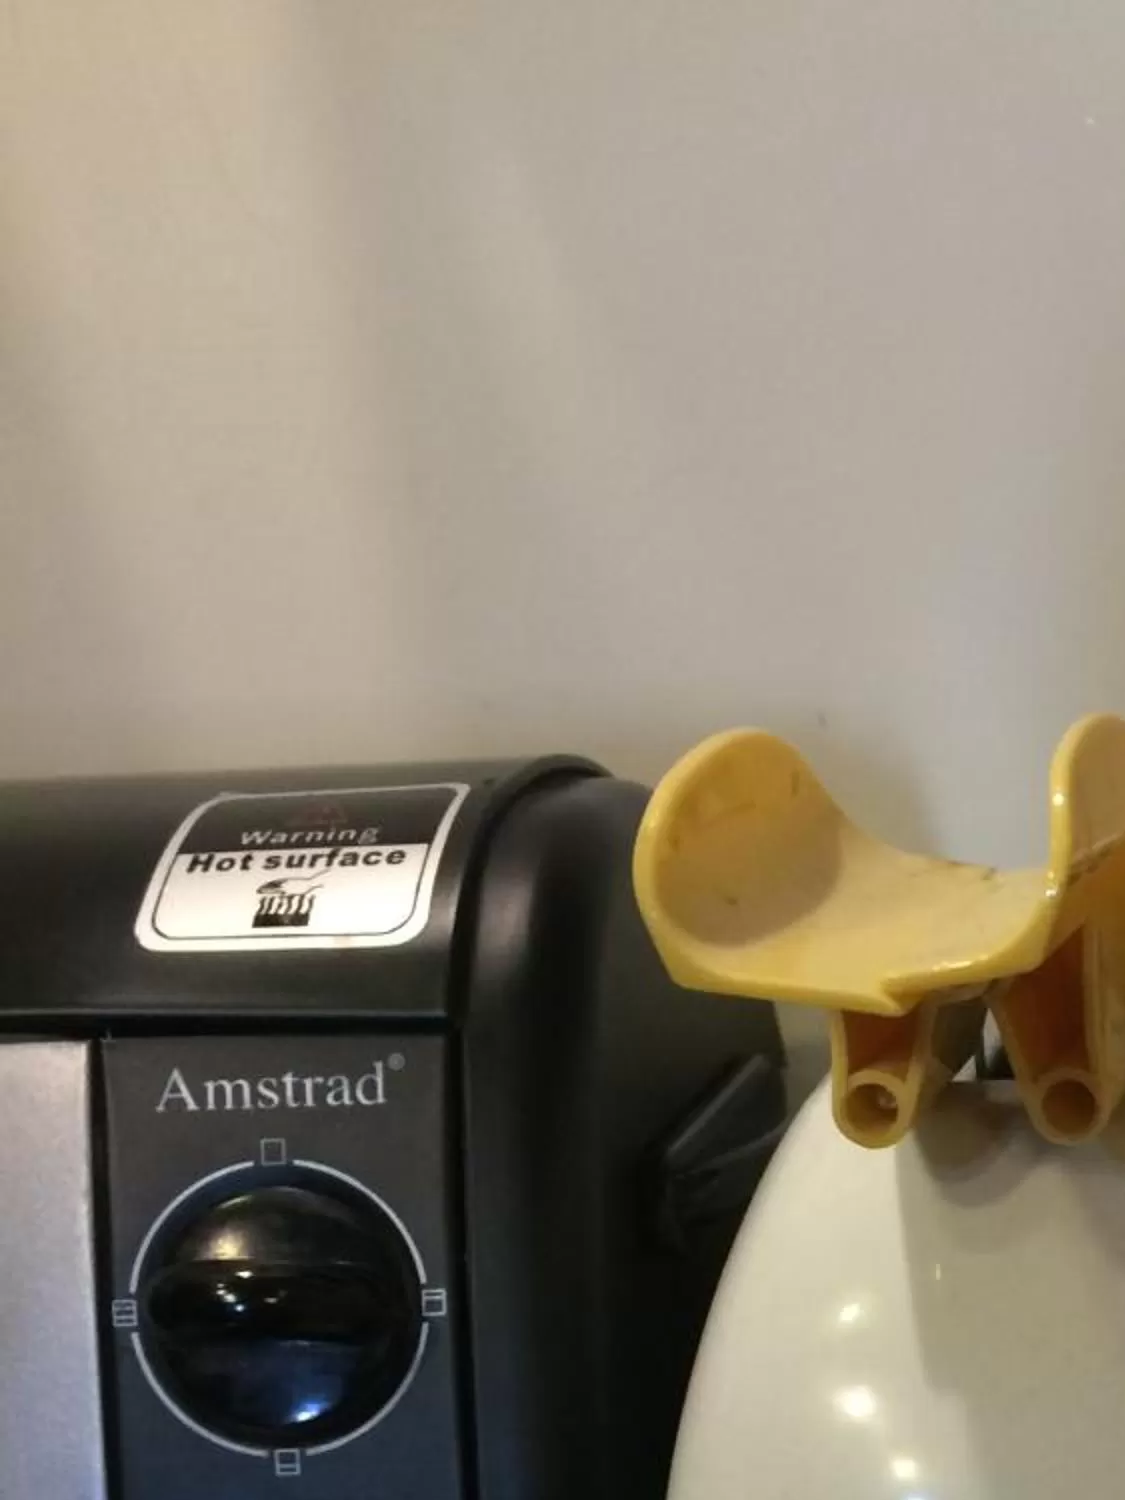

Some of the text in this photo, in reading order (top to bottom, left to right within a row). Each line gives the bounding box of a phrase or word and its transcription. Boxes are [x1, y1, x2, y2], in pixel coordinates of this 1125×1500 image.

[239, 826, 381, 846] Warning
[185, 847, 406, 873] Hot surface
[155, 1061, 388, 1112] Amstrad
